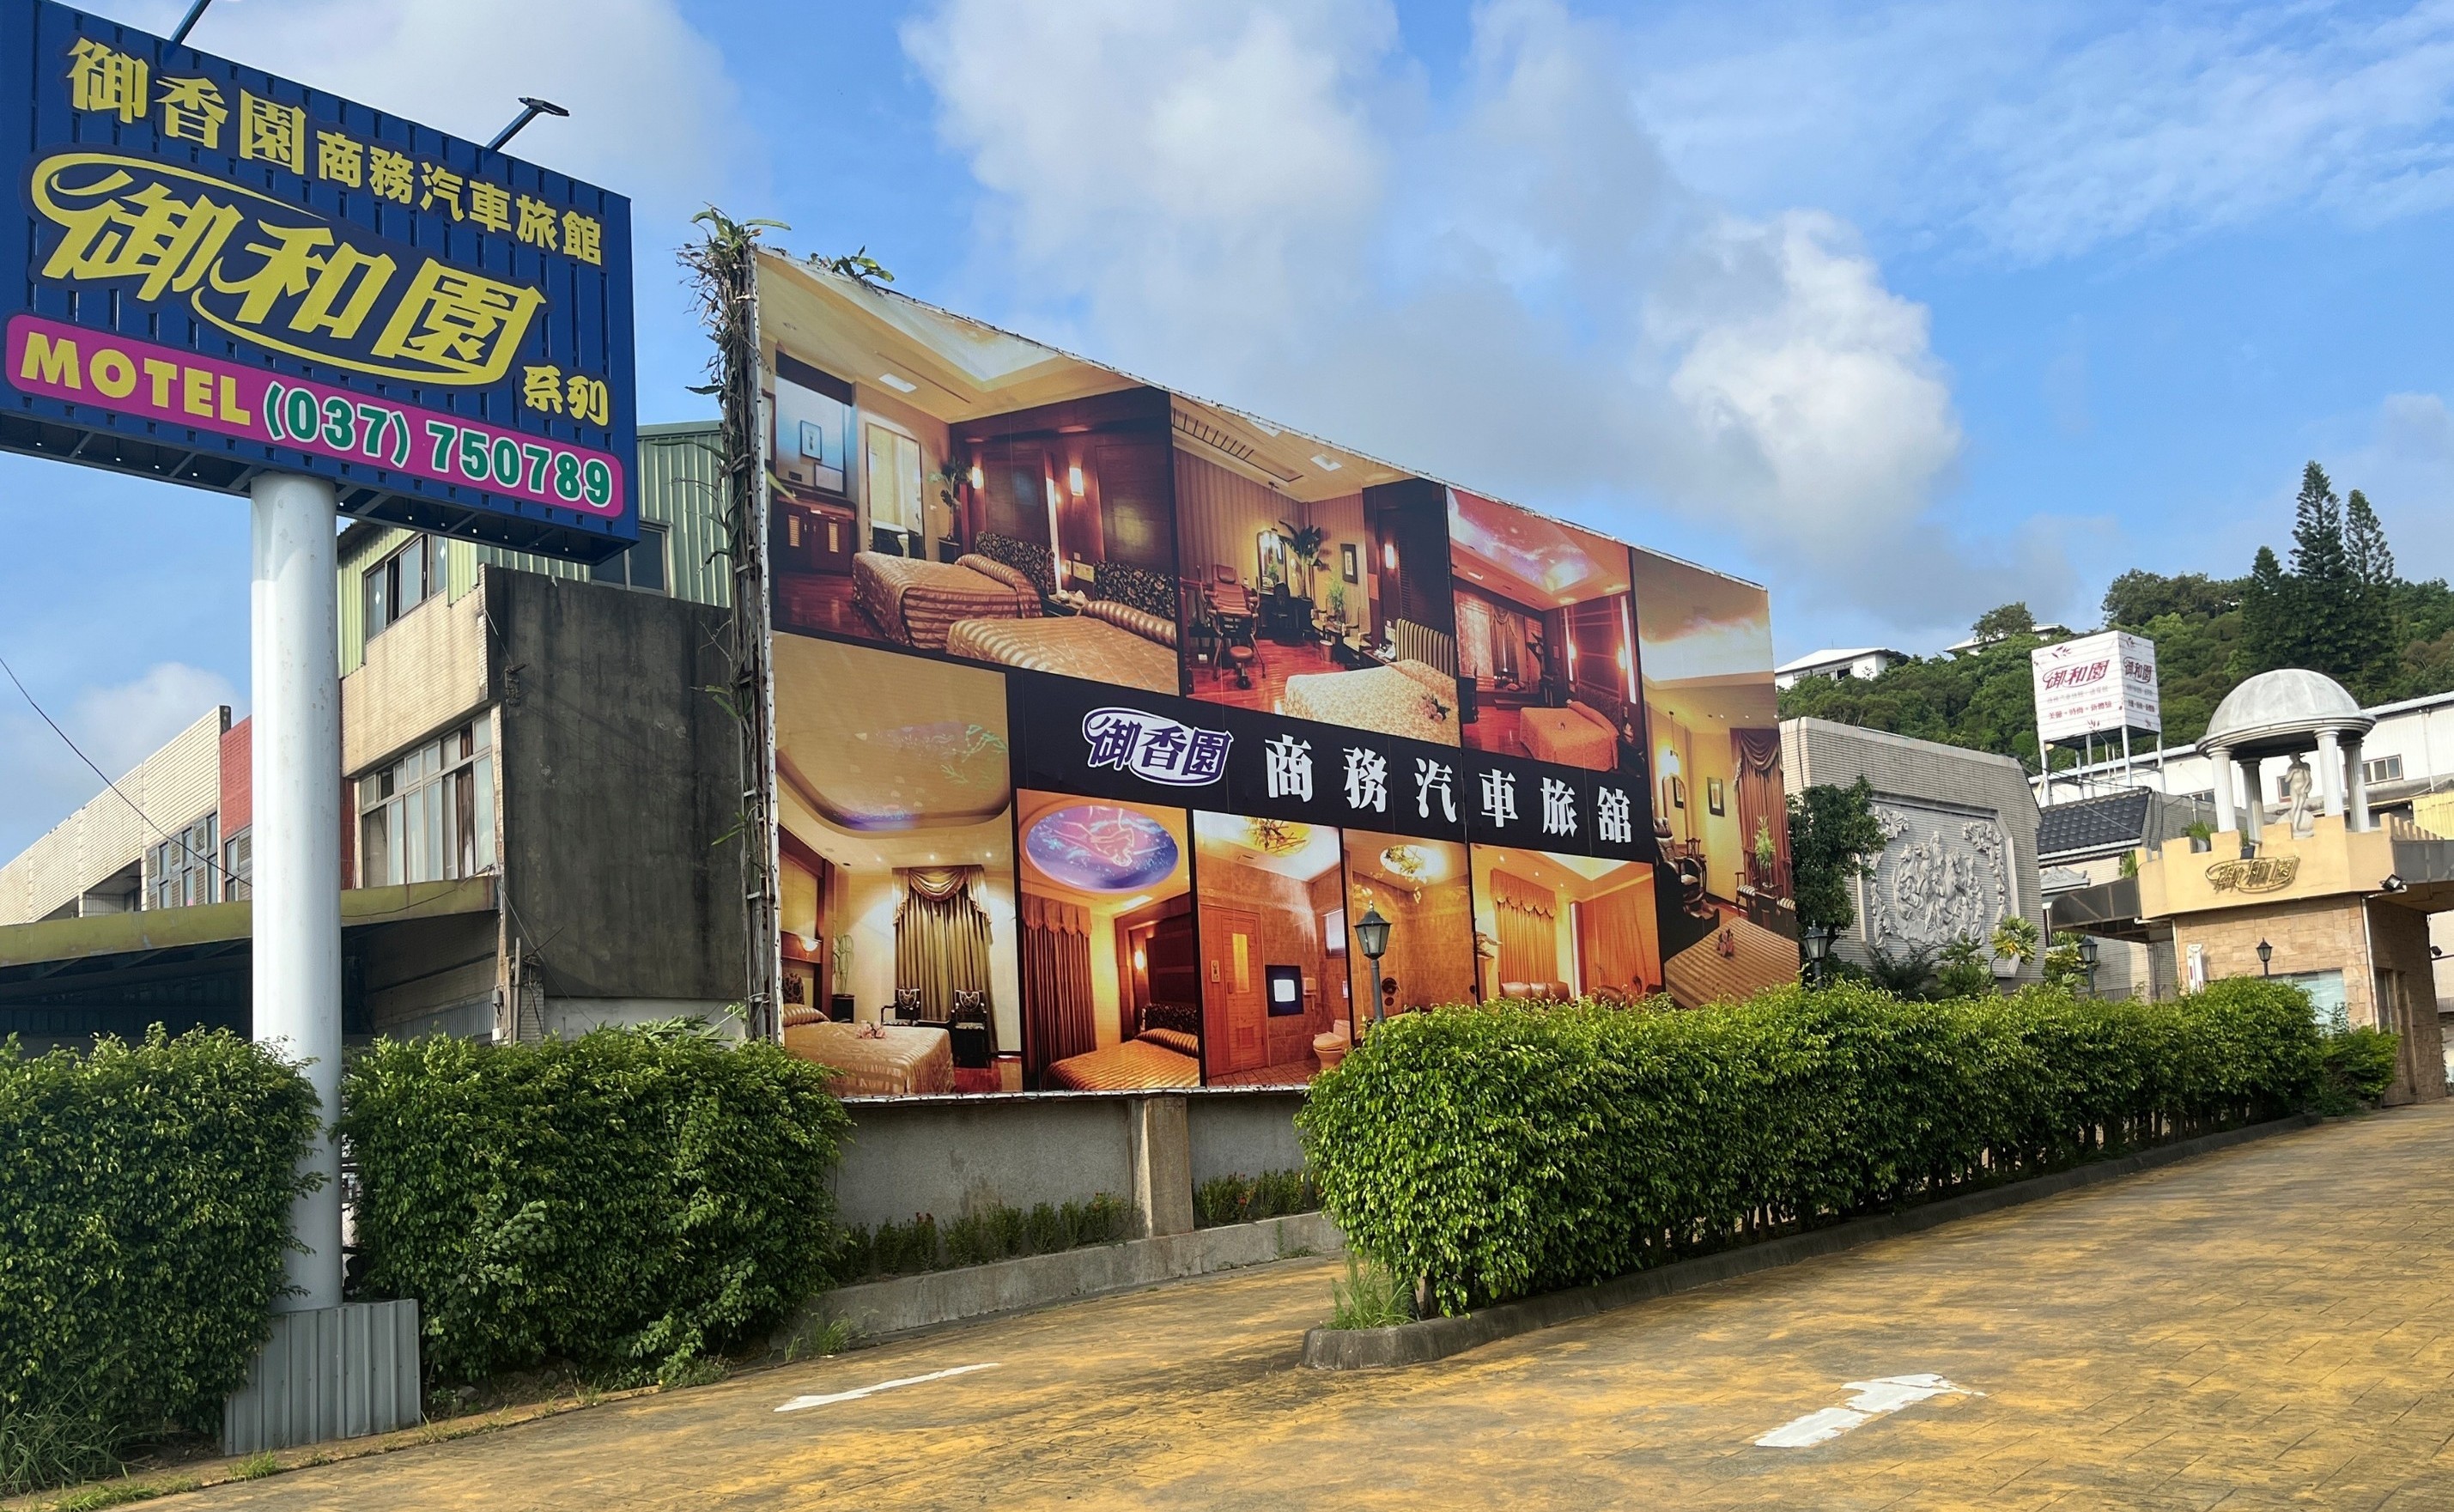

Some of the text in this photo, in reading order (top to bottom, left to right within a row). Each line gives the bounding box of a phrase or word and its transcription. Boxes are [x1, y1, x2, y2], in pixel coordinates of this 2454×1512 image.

[31, 153, 547, 386] 御和園
[20, 331, 612, 508] MOTEL (037) 750789
[523, 365, 609, 427] 系列
[2043, 659, 2111, 690] 御和園
[1083, 707, 1234, 786] 御香園
